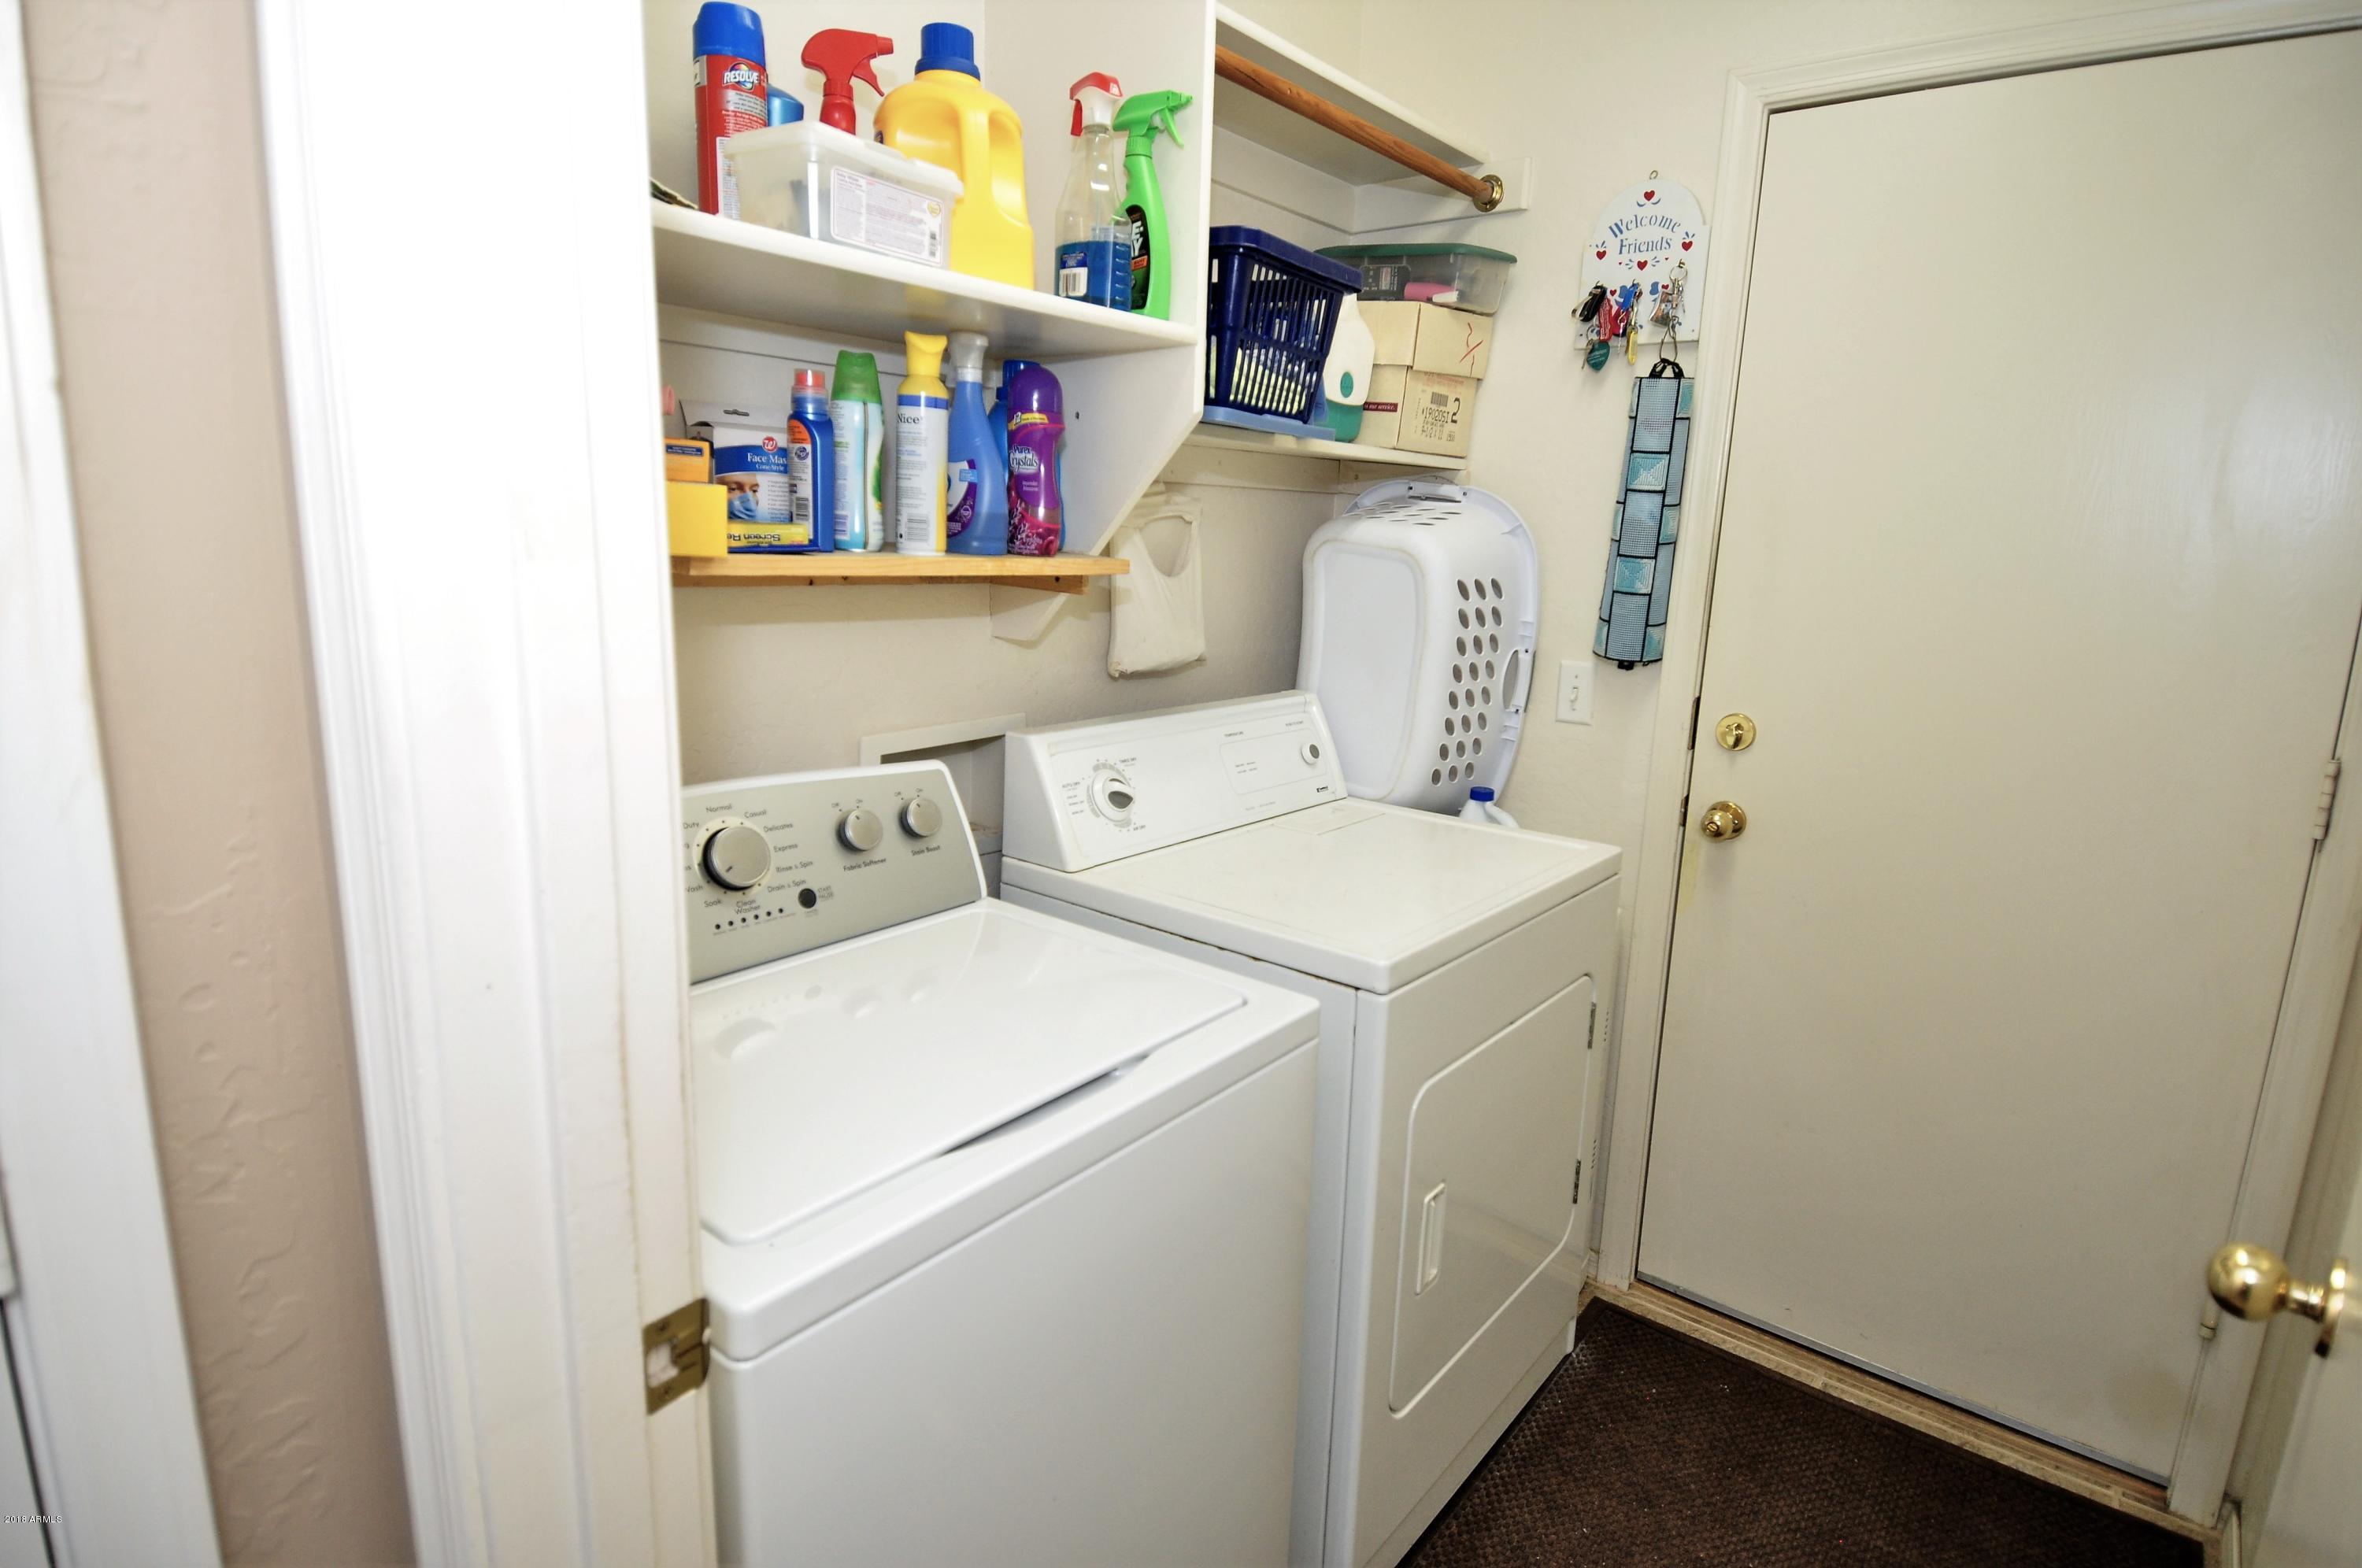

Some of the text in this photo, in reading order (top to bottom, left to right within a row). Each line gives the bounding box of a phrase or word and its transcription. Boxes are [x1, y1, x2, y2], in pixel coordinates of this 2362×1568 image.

[724, 70, 760, 84] RESOLVE
[1608, 214, 1681, 239] Welcome
[1619, 236, 1672, 255] Friends
[1451, 397, 1461, 423] 2
[747, 452, 787, 464] Face Mas
[1009, 452, 1038, 474] Crystals
[705, 804, 732, 812] Normal
[744, 809, 767, 818] Casual
[763, 823, 793, 833] Delicates
[773, 844, 798, 852] Express
[799, 860, 813, 870] Spin
[843, 857, 887, 872] Fabric Softener
[768, 884, 785, 893] Drain
[792, 879, 806, 888] Spin
[704, 898, 722, 908] Soak
[736, 899, 756, 908] Clean
[734, 905, 761, 915] Washer
